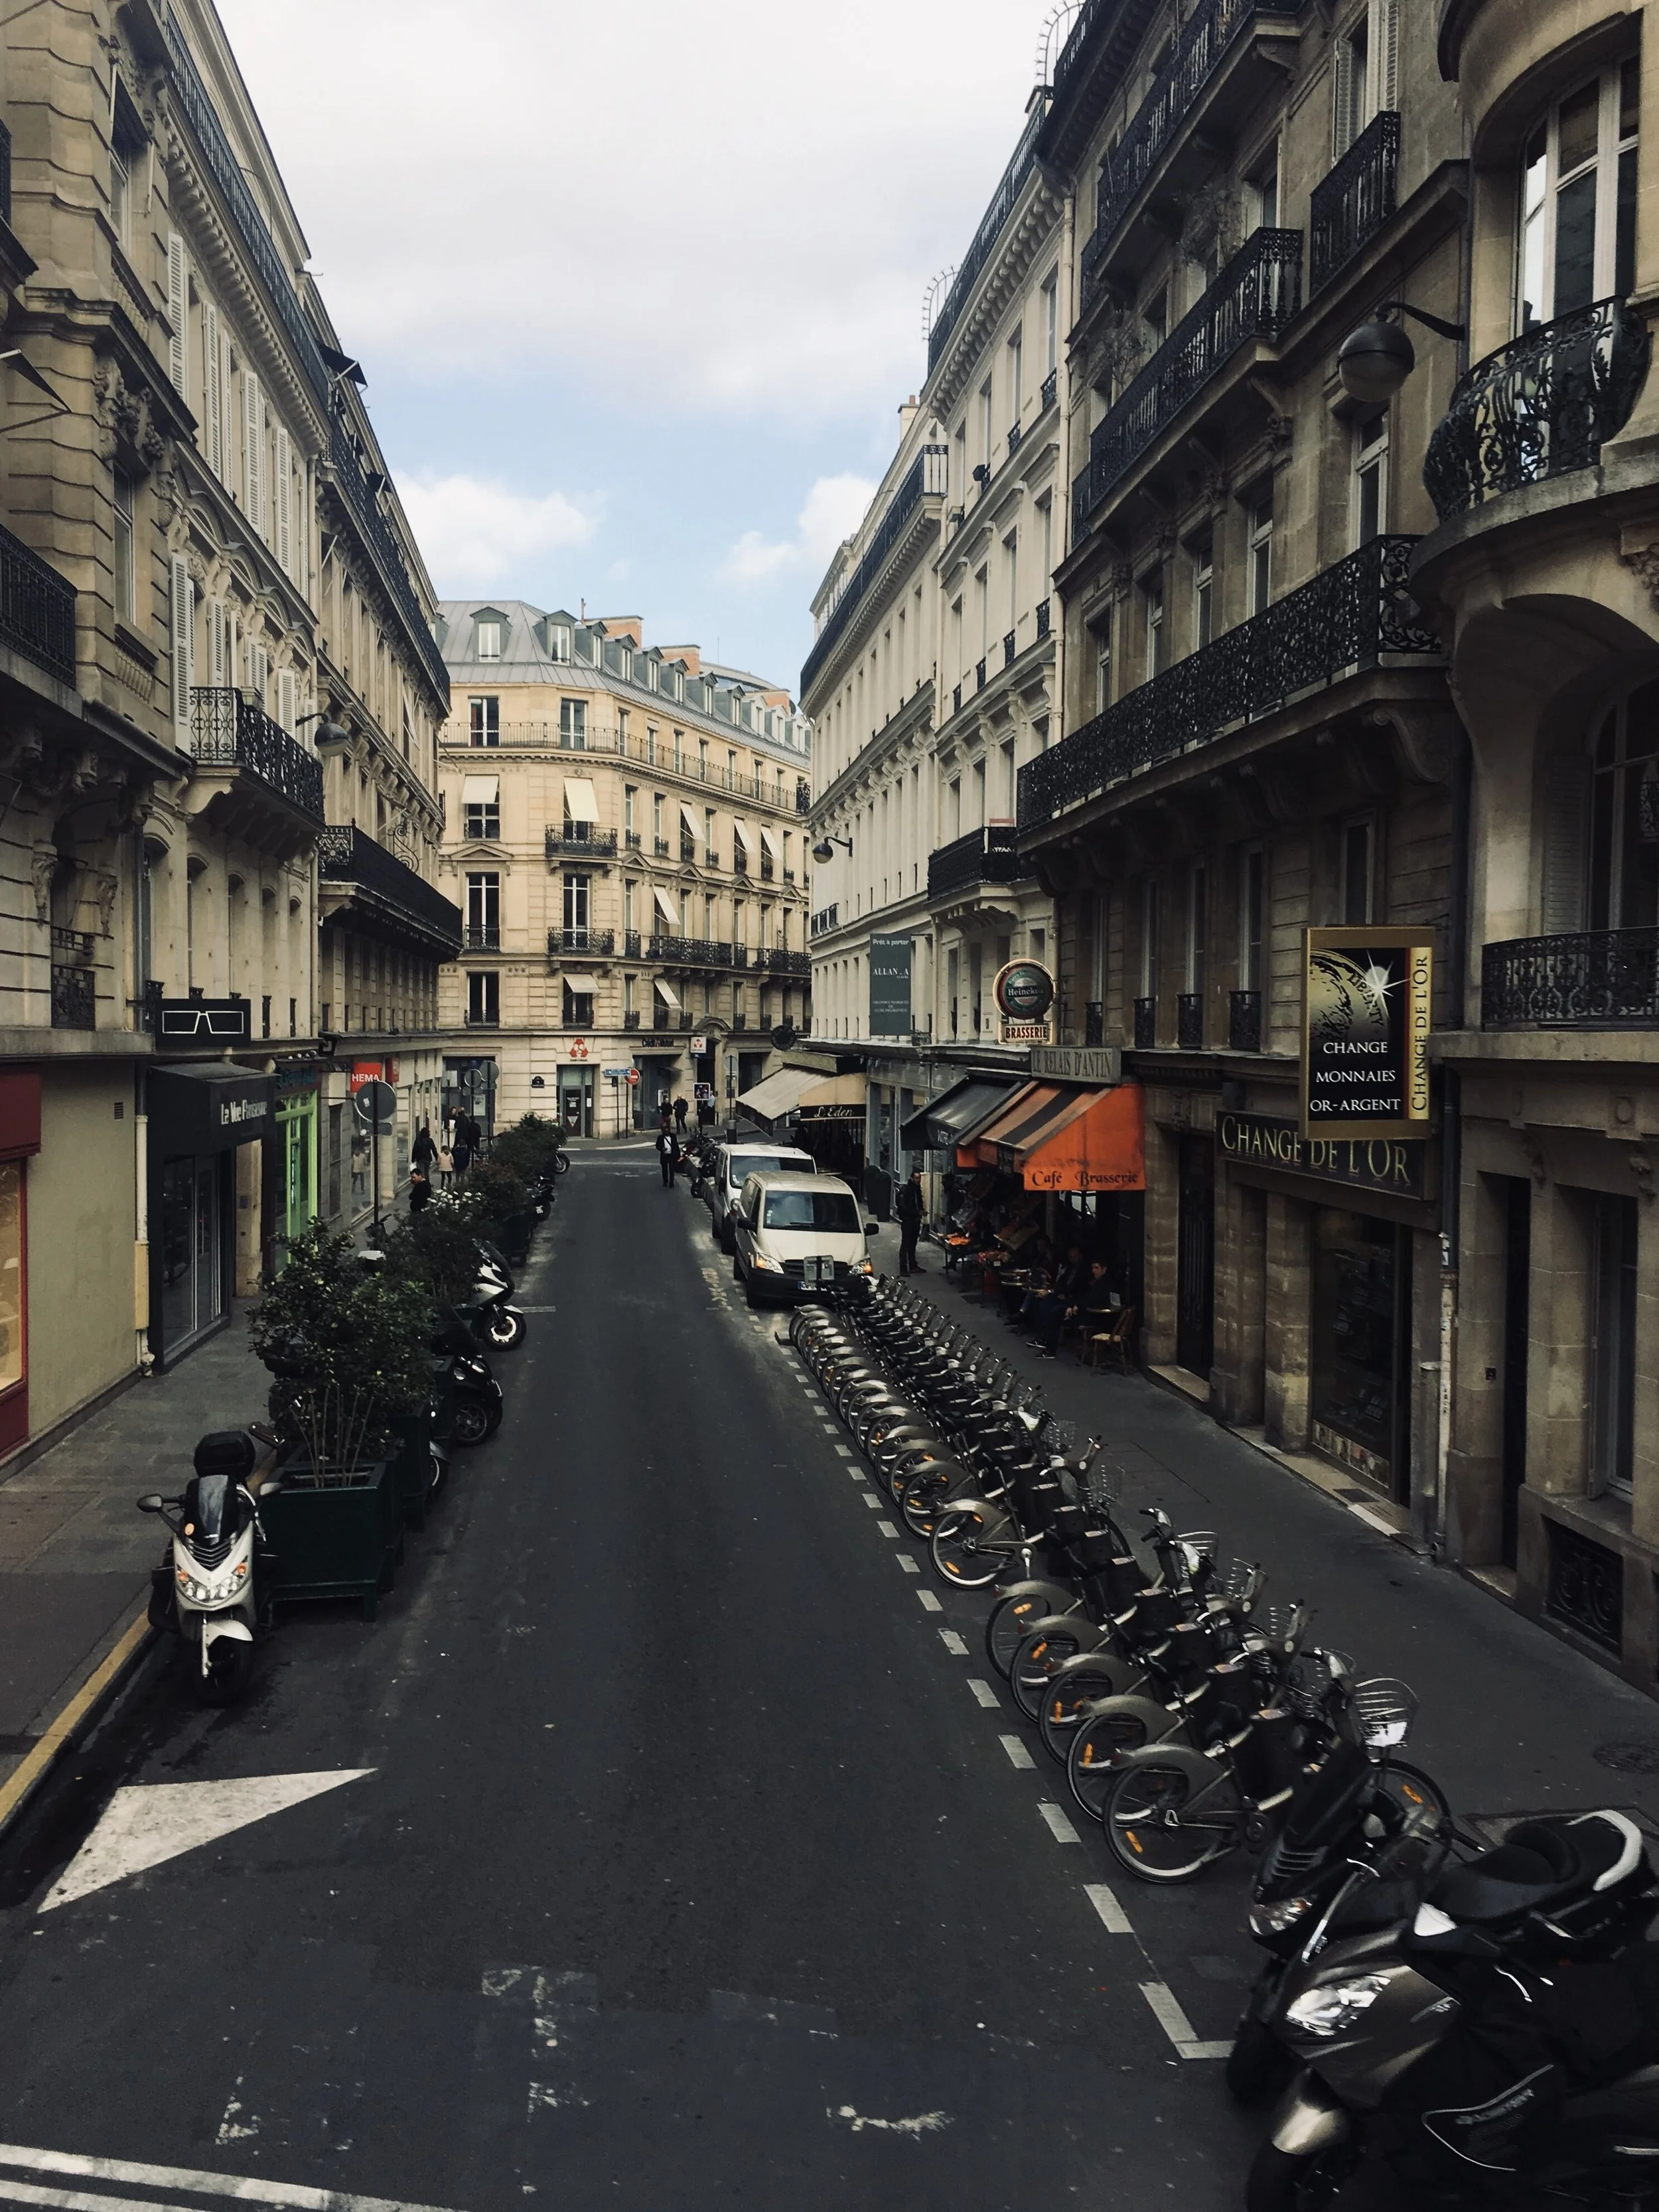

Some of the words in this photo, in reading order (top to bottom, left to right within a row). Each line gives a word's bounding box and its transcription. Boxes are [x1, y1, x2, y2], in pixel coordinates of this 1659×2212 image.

[1411, 955, 1428, 998] L'OR
[1415, 1006, 1427, 1028] DE
[1005, 1026, 1047, 1039] BRASSERIE
[1323, 1042, 1388, 1054] CHANGE
[1044, 1050, 1071, 1075] RELAIS
[1074, 1052, 1112, 1078] D'ANTIN
[1412, 1035, 1427, 1111] CHANGE
[352, 1073, 380, 1082] HEMA
[1316, 1070, 1396, 1083] MONNAIES
[221, 1103, 229, 1125] La
[1310, 1099, 1402, 1111] OR-ARGENT
[1222, 1116, 1301, 1162] CHANGE
[1311, 1140, 1338, 1170] DE
[1032, 1170, 1062, 1188] Café
[1075, 1171, 1139, 1187] Brasserie
